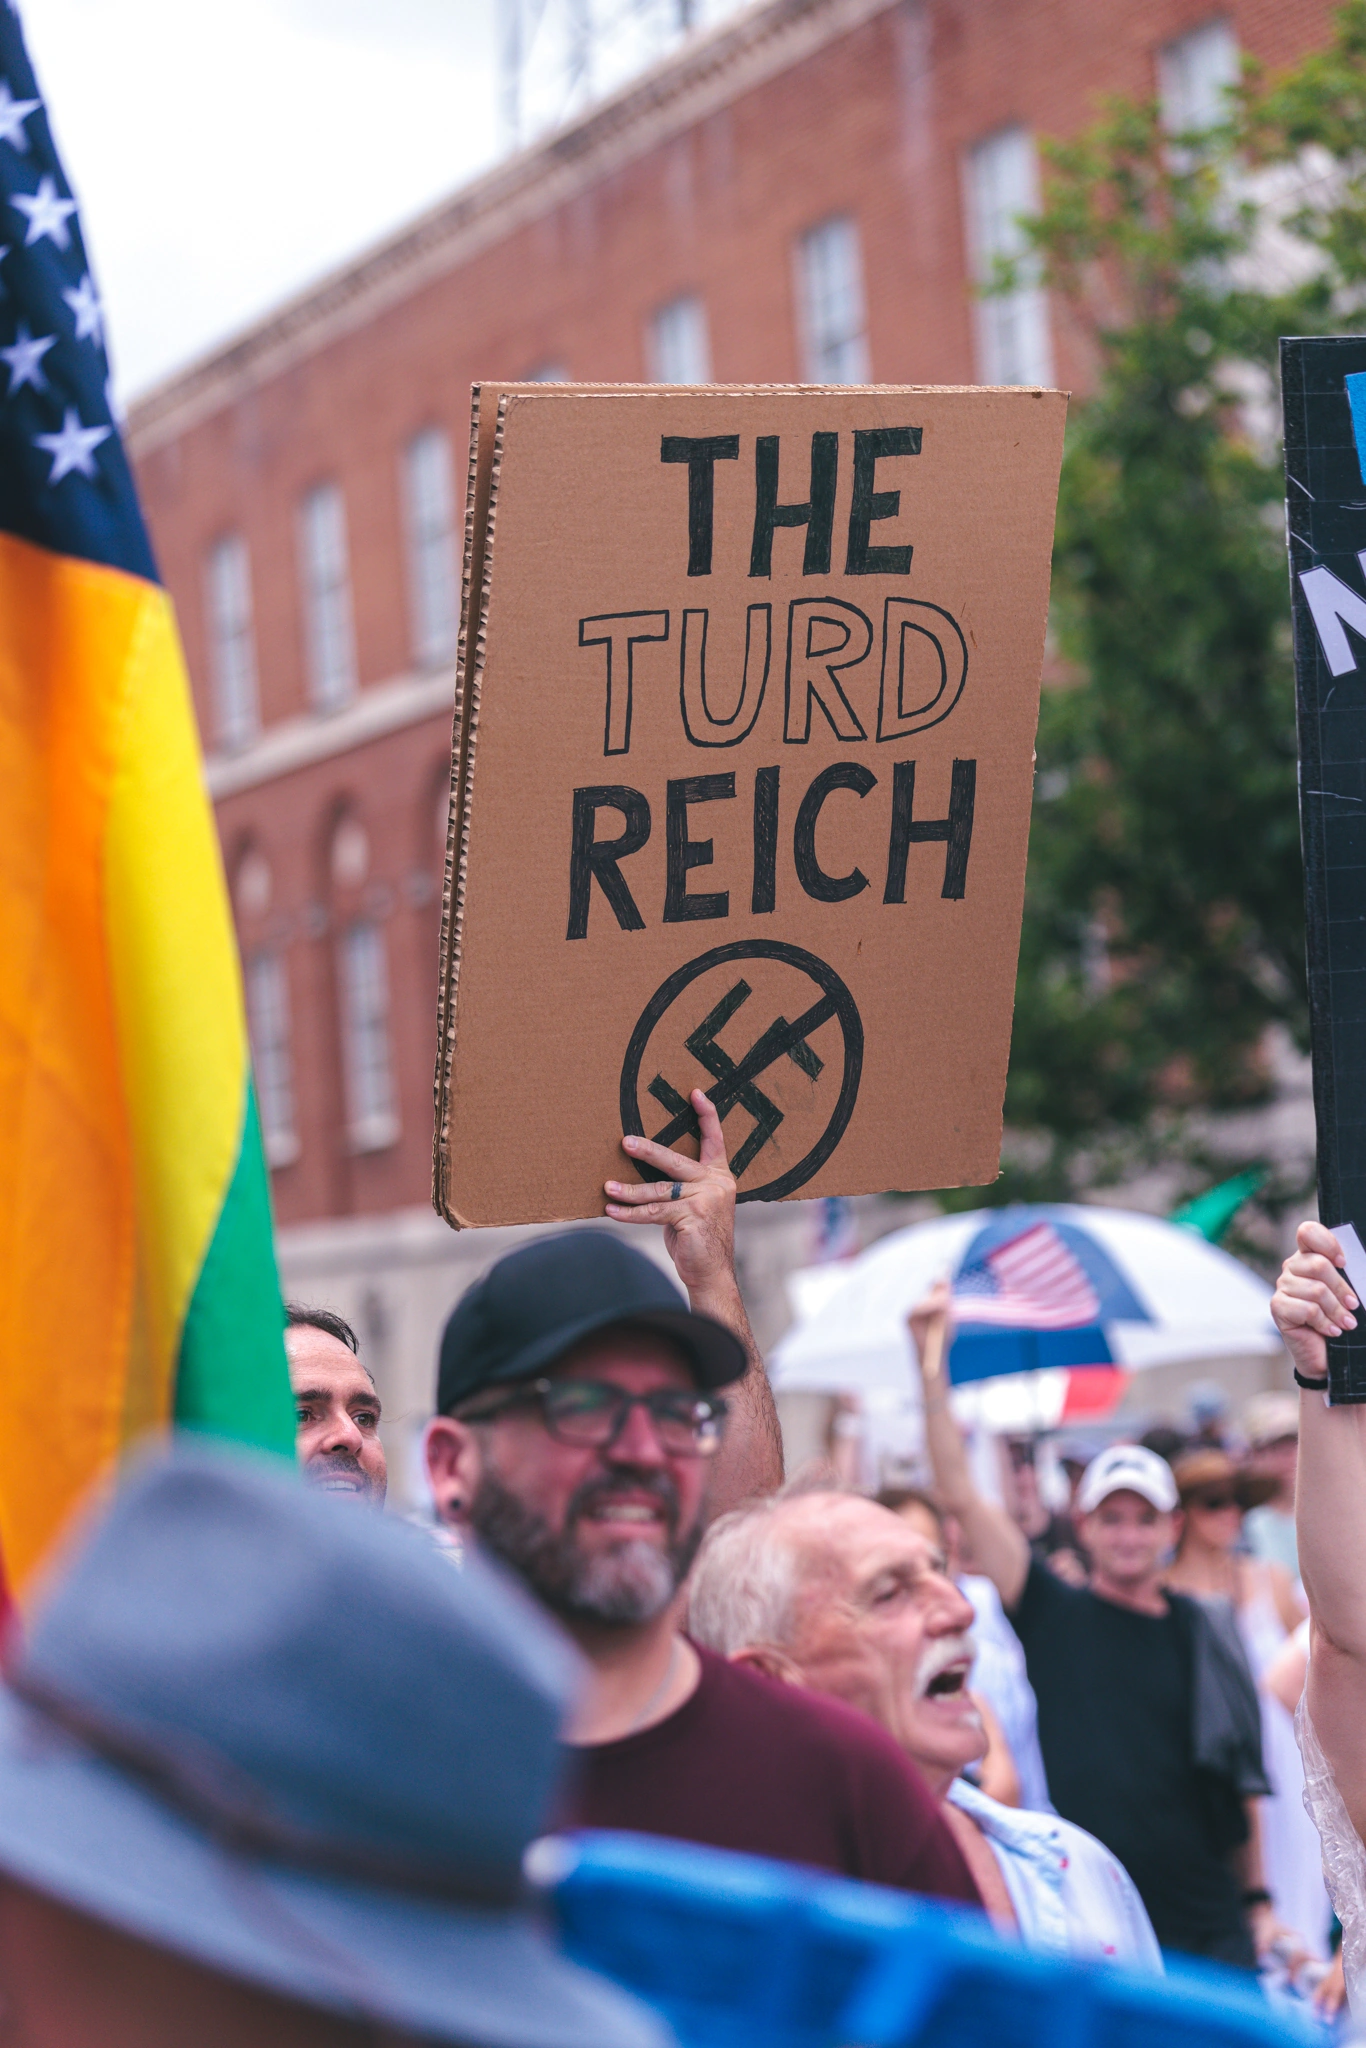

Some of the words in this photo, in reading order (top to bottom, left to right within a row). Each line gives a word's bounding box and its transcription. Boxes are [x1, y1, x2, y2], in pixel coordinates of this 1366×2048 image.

[660, 426, 924, 580] THE
[578, 596, 969, 757] TURD
[565, 758, 977, 941] REICH
